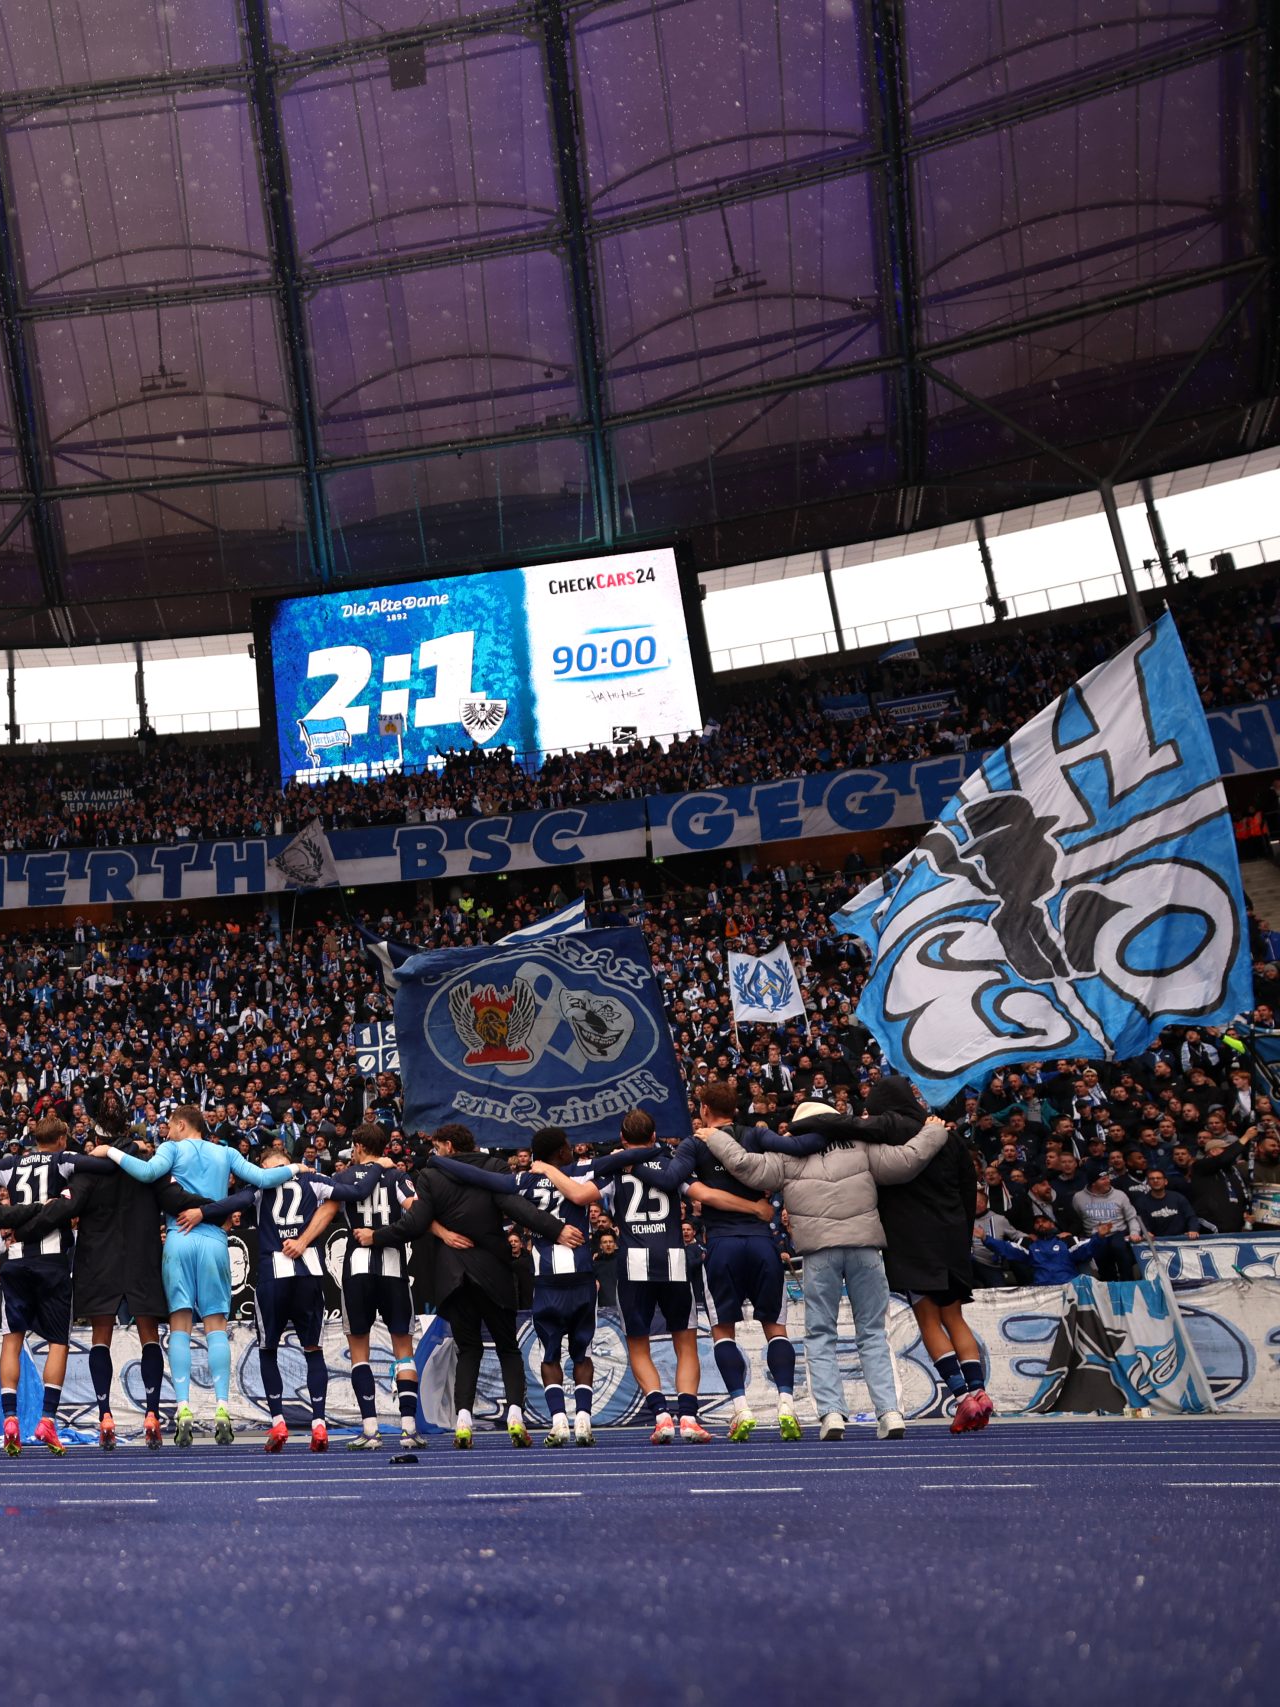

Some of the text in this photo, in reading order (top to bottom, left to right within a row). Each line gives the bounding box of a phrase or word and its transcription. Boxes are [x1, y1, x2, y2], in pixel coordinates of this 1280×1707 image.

[548, 566, 656, 595] CHECKCARS24
[341, 593, 450, 618] Die Alte Dame
[386, 612, 408, 622] 1892
[552, 635, 657, 675] 90:00
[311, 730, 349, 745] Hertha BSC
[61, 790, 87, 801] SEXY
[393, 809, 588, 880] BSC
[667, 753, 984, 850] GEGE
[15, 1164, 49, 1206] 31
[631, 1222, 667, 1235] EICHHORN
